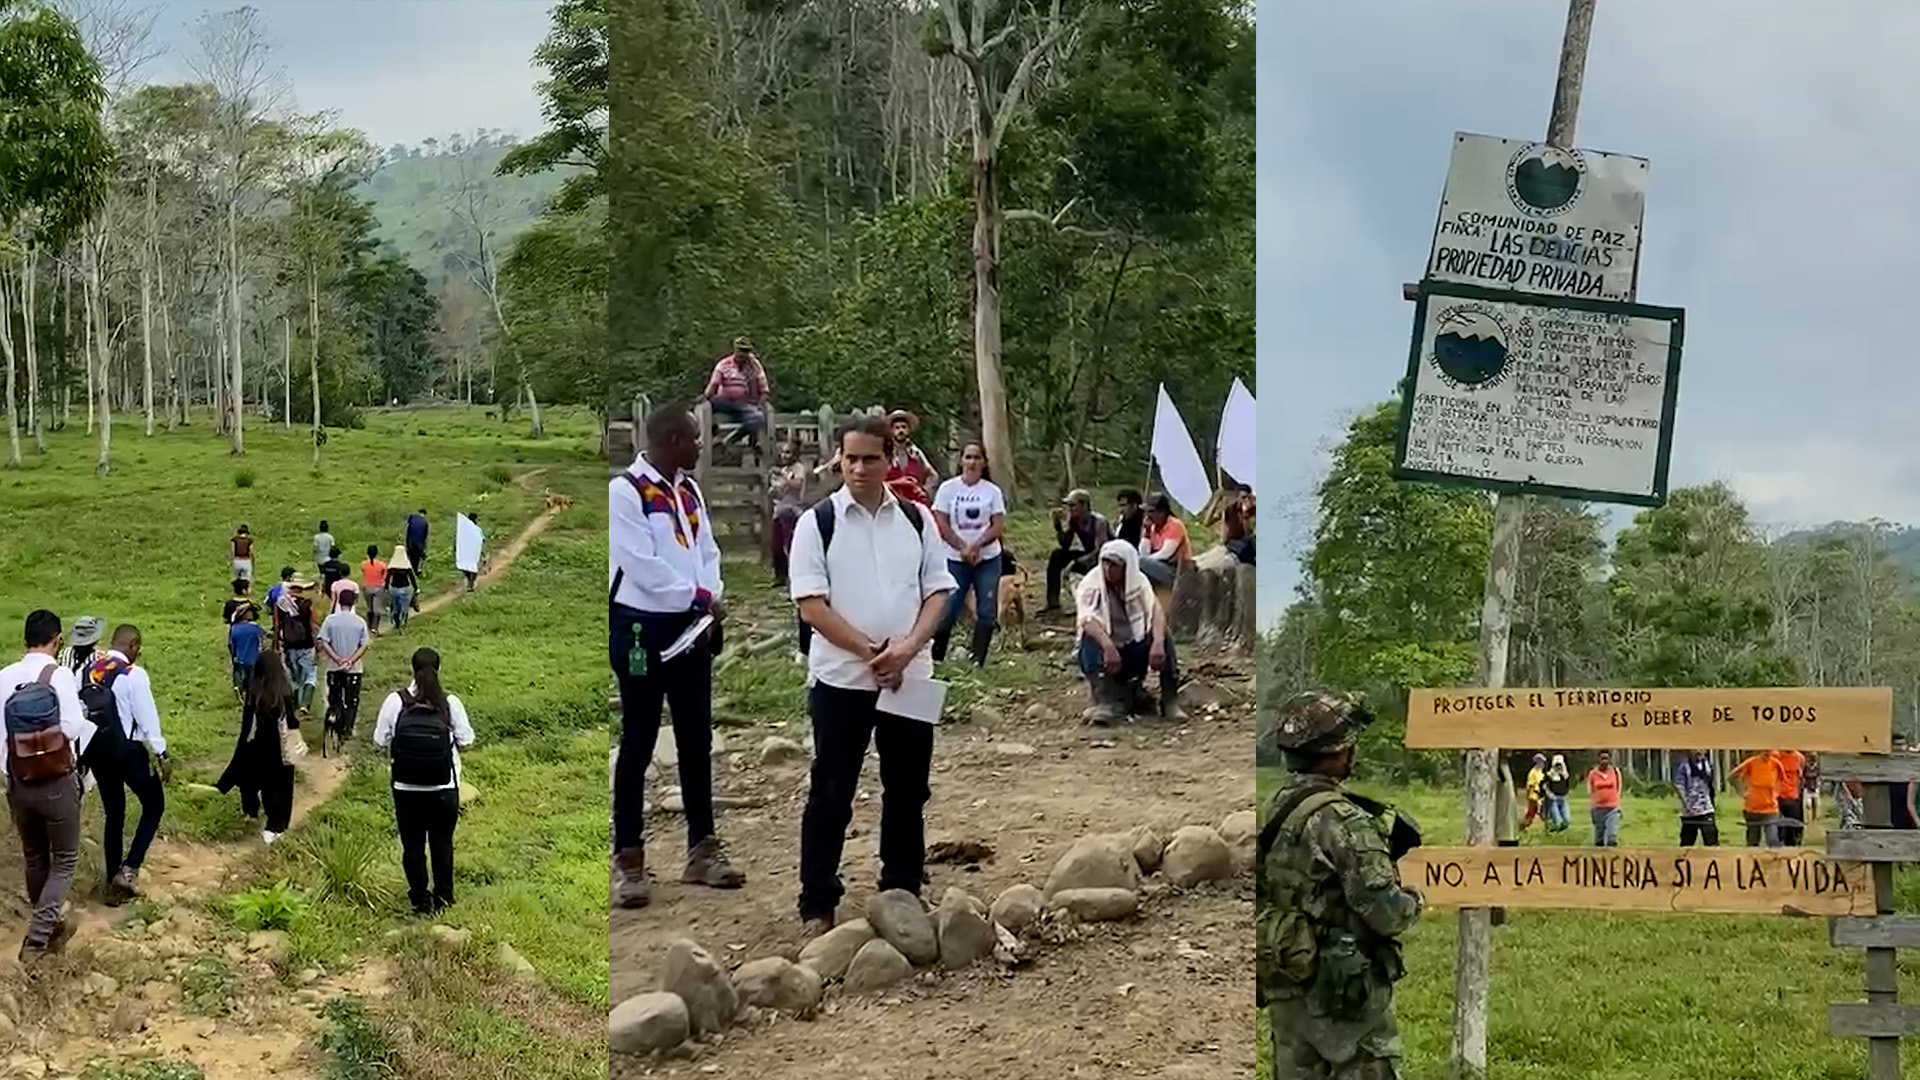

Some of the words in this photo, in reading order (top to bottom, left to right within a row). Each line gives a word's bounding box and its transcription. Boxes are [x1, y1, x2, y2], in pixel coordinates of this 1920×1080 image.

[1458, 212, 1557, 235] COMUNIDAD
[1566, 227, 1586, 240] DE
[1592, 230, 1626, 246] PAZ
[1436, 247, 1526, 283] PROPIEDAD
[1490, 230, 1524, 256] LAS
[1530, 236, 1613, 267] DELICIAS
[1486, 401, 1501, 413] EN
[1434, 695, 1515, 714] PROTEGER
[1529, 693, 1545, 707] EL
[1554, 691, 1652, 707] TERRITORIO
[1611, 713, 1628, 727] ES
[1644, 710, 1692, 726] DEBER
[1713, 707, 1734, 723] DE
[1752, 705, 1817, 723] TODOS
[1484, 861, 1501, 886] A
[1514, 857, 1544, 886] LA
[1562, 856, 1658, 890] MINERIA
[1672, 858, 1691, 888] SI
[1704, 860, 1721, 890] A
[1736, 857, 1767, 890] LA
